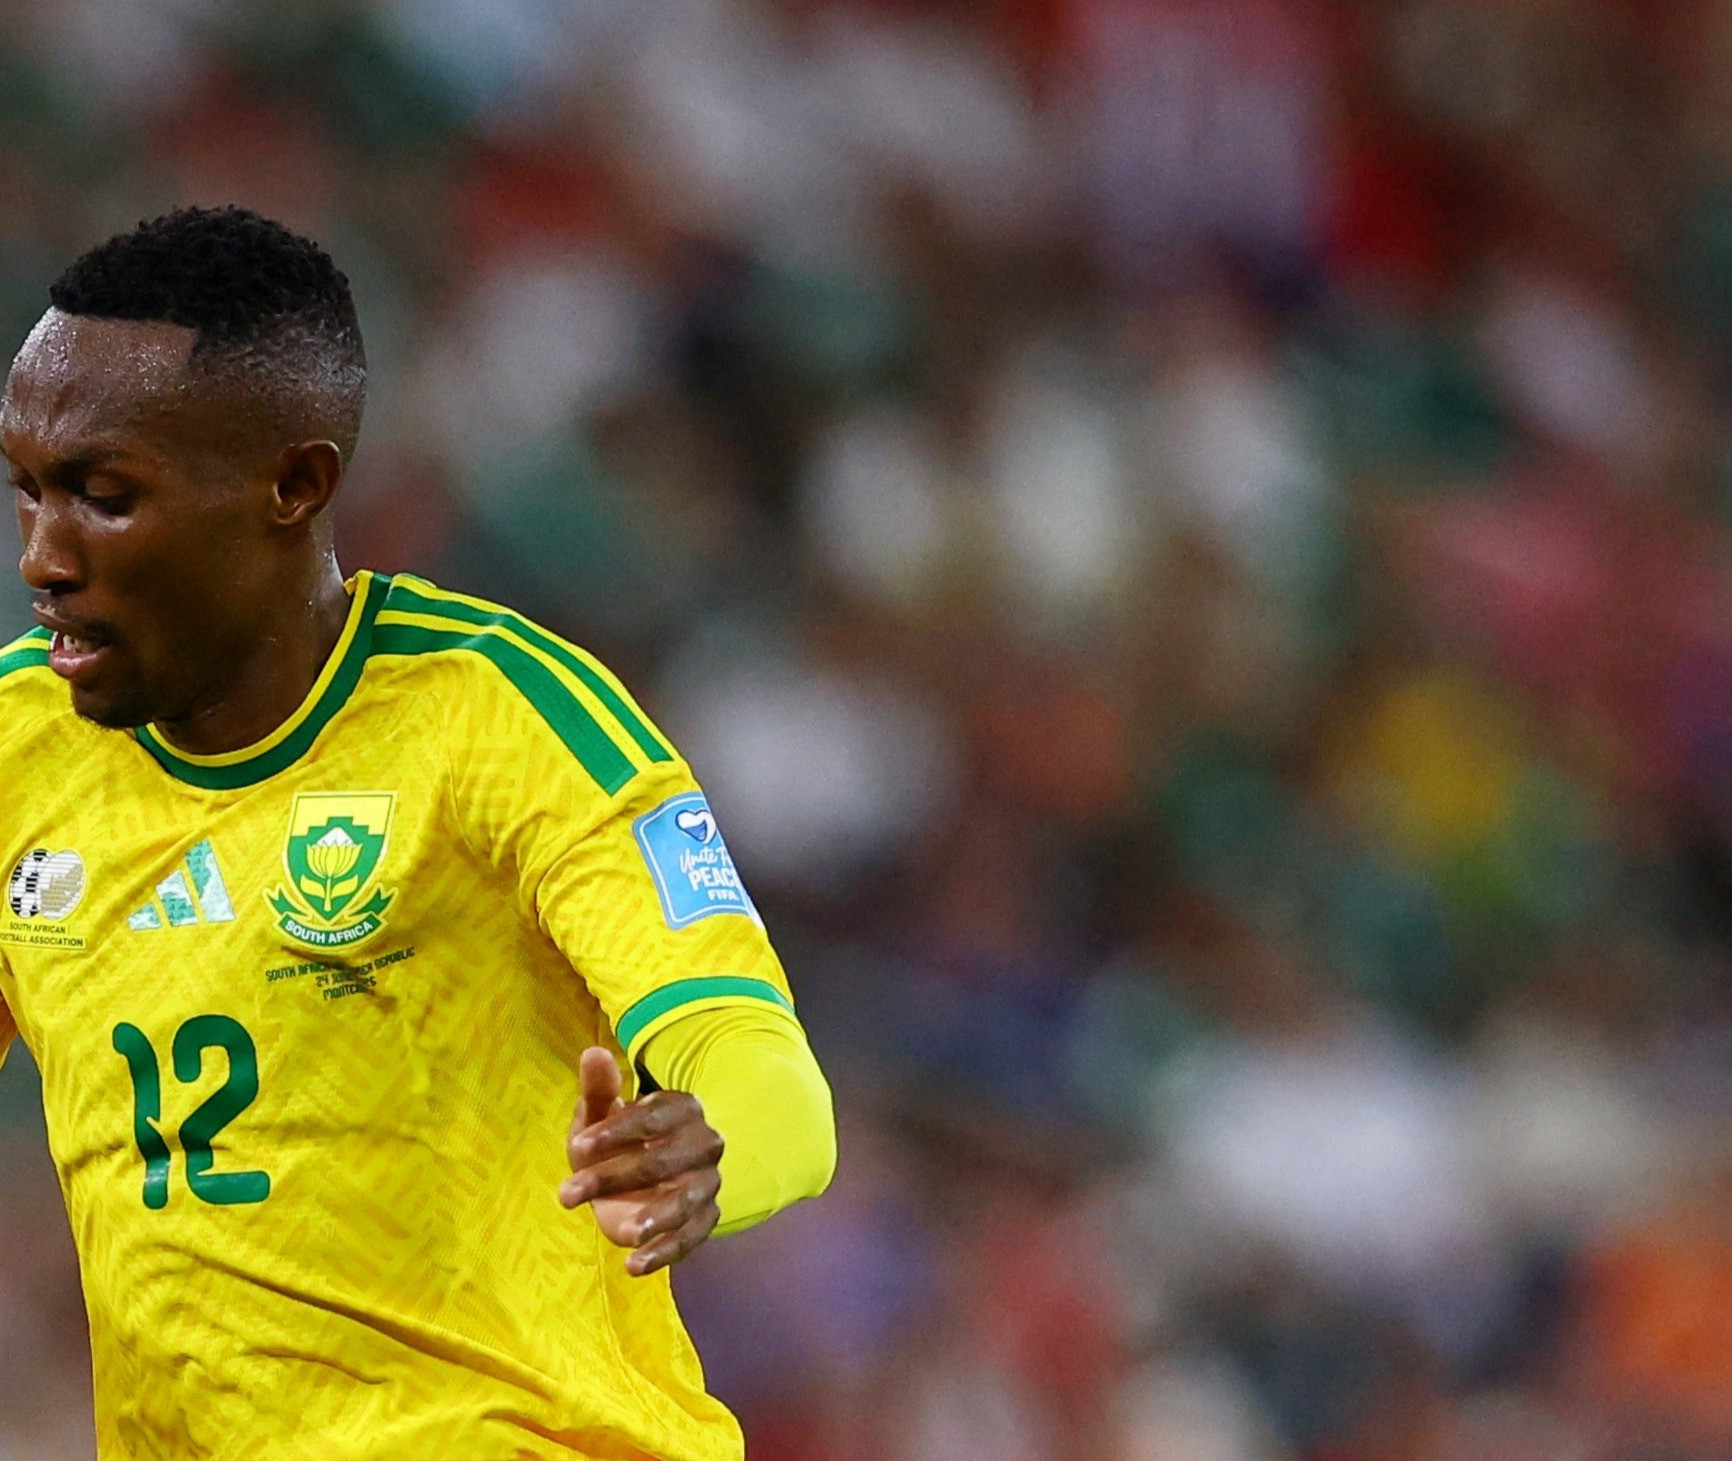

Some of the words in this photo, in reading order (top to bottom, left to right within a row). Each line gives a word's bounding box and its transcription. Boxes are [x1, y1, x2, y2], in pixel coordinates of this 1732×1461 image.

[679, 847, 718, 873] Unite
[707, 889, 740, 901] FIFA
[9, 921, 32, 931] SOUTH
[33, 924, 66, 934] AFRICAN
[285, 920, 326, 944] SOUTH
[328, 921, 373, 944] AFRICA
[29, 935, 83, 947] ASSOCIATION
[265, 968, 296, 982] SOUTH
[374, 946, 416, 969] REPUBLIC
[316, 975, 329, 987] 24
[111, 1014, 271, 1210] 12
